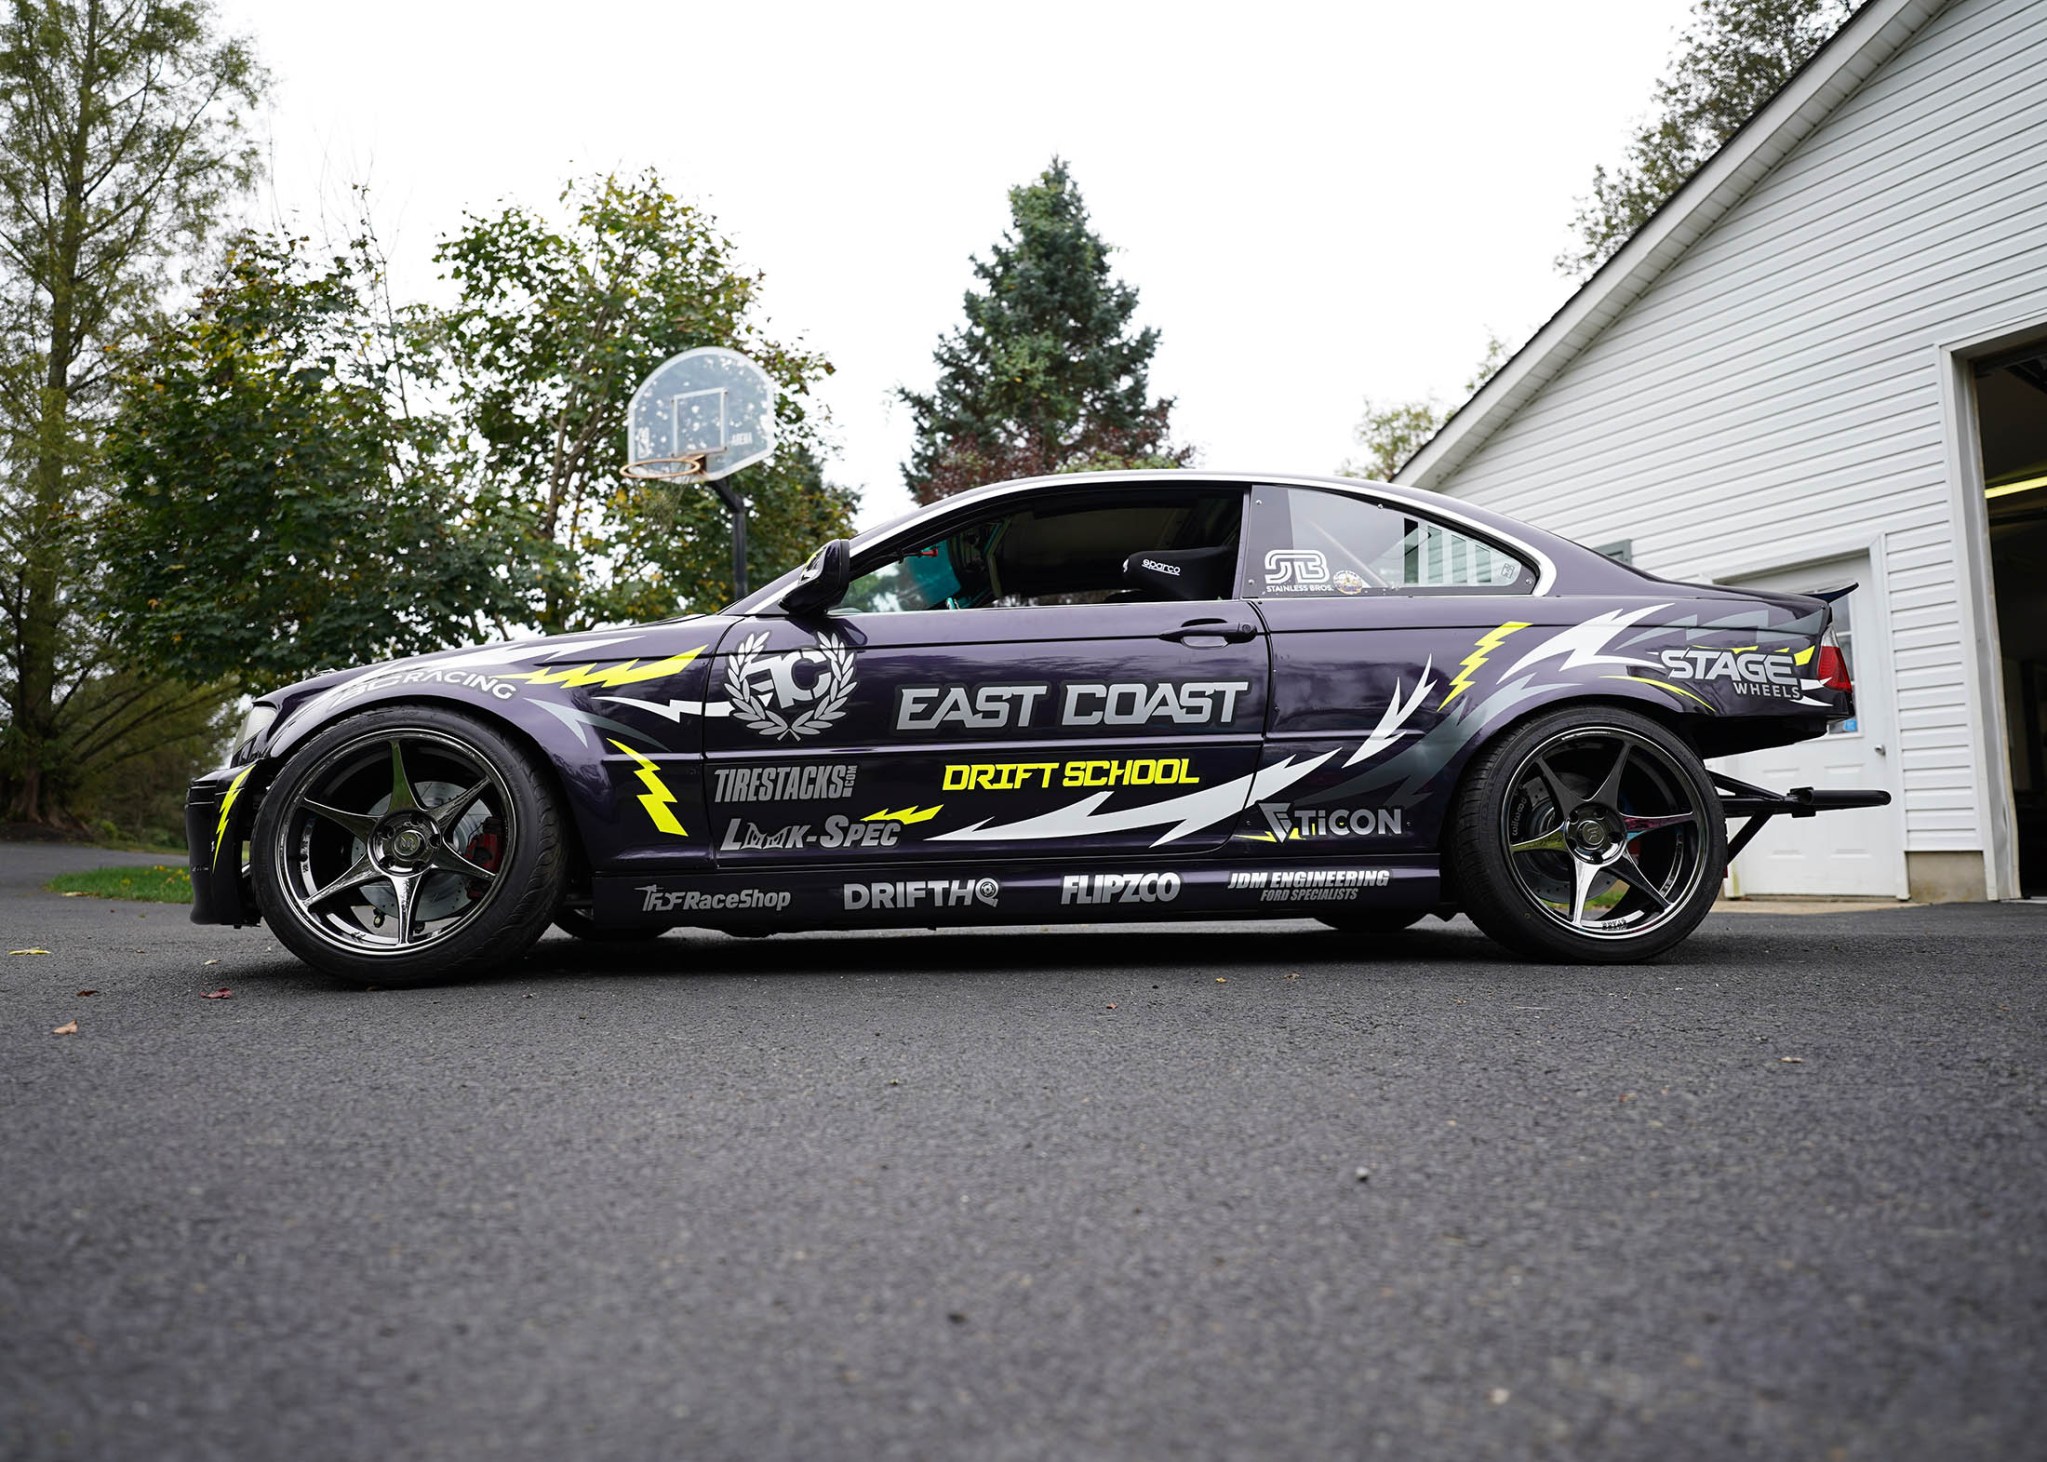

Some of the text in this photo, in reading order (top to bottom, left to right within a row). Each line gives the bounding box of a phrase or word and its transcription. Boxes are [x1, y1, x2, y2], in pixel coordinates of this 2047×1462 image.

[1141, 558, 1181, 576] sparco
[1266, 584, 1309, 593] STAINLESS
[1660, 647, 1798, 685] STAGE
[402, 670, 517, 700] RACING
[1733, 682, 1801, 699] WHEELS
[896, 681, 1249, 730] EAST COAST
[714, 764, 846, 803] TIRESTACKS
[942, 758, 1200, 791] DRIFT SCHOOL
[1061, 871, 1182, 905] FLIPZCO
[1227, 870, 1391, 889] JDM ENGINEERING
[1260, 888, 1359, 902] FORD SPECIALISTS
